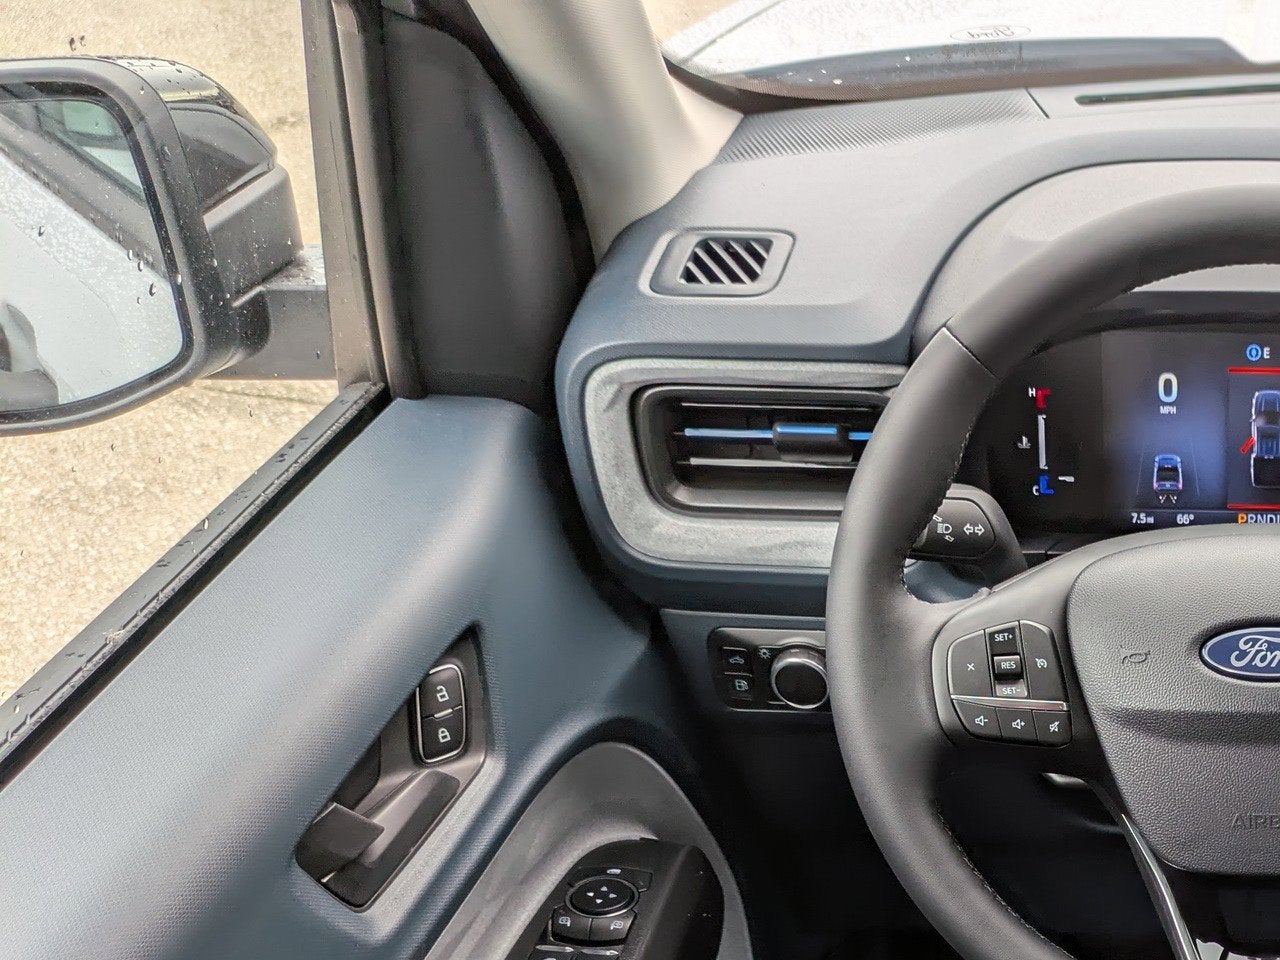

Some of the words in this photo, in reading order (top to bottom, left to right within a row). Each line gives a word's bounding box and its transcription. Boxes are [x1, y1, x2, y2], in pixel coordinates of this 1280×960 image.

[1028, 387, 1036, 397] H
[1158, 372, 1178, 403] 0
[1160, 405, 1177, 415] MPH
[1001, 661, 1016, 670] RES
